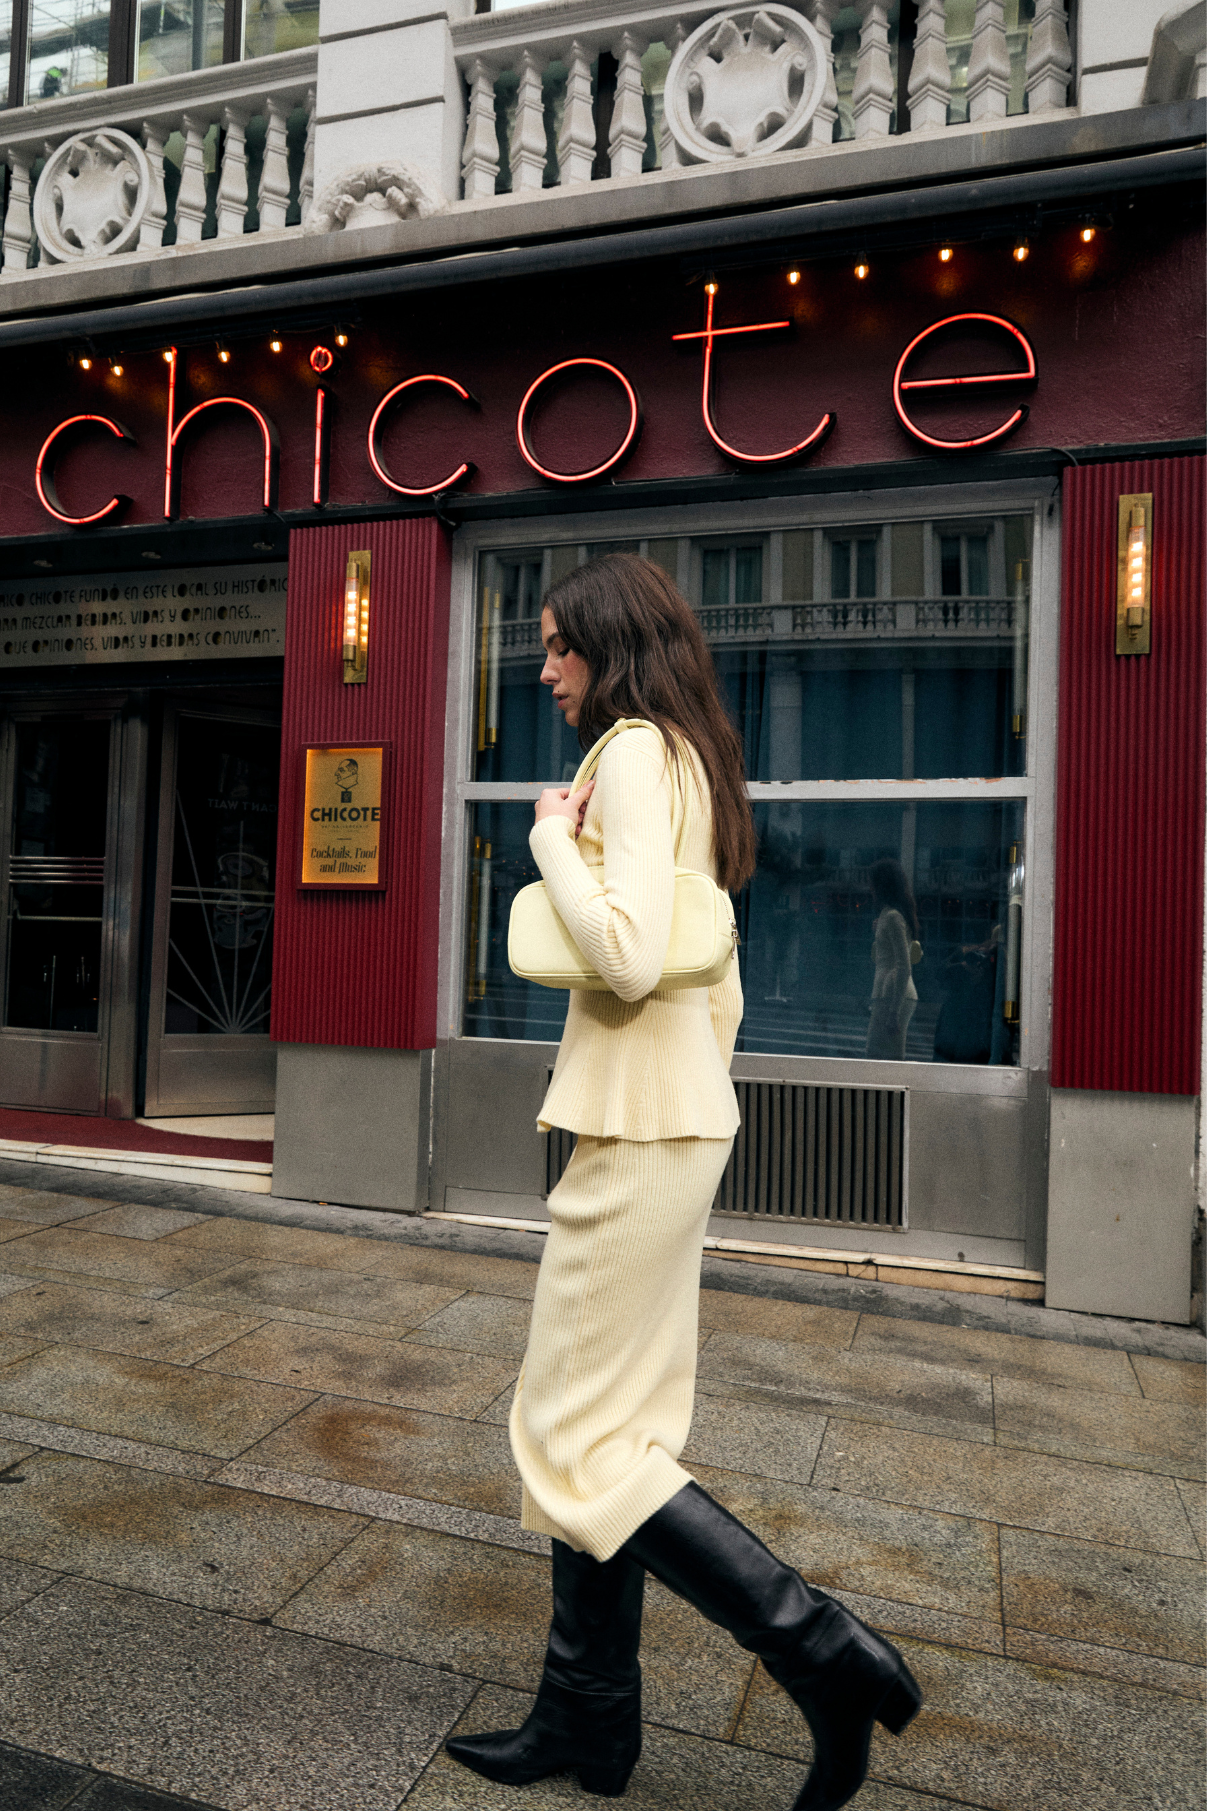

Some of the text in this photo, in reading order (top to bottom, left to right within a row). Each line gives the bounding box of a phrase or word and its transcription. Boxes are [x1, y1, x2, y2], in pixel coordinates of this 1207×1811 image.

[34, 285, 1037, 525] chicote
[30, 590, 75, 605] CHICOTE
[80, 584, 119, 603] FUNDÓ
[124, 586, 139, 600] EN
[143, 584, 167, 599] ESTE
[172, 582, 209, 598] LOCAL
[214, 581, 227, 596] SU
[0, 617, 17, 631] RA
[22, 614, 72, 630] MEZCLAR
[131, 609, 165, 625] VIDAS
[169, 608, 177, 623] Y
[102, 634, 135, 650] VIDAS
[140, 634, 147, 649] Y
[151, 632, 200, 648] BEBIDAS
[310, 807, 381, 822] CHICOTE
[355, 846, 377, 859] Food
[319, 859, 367, 874] and Music
